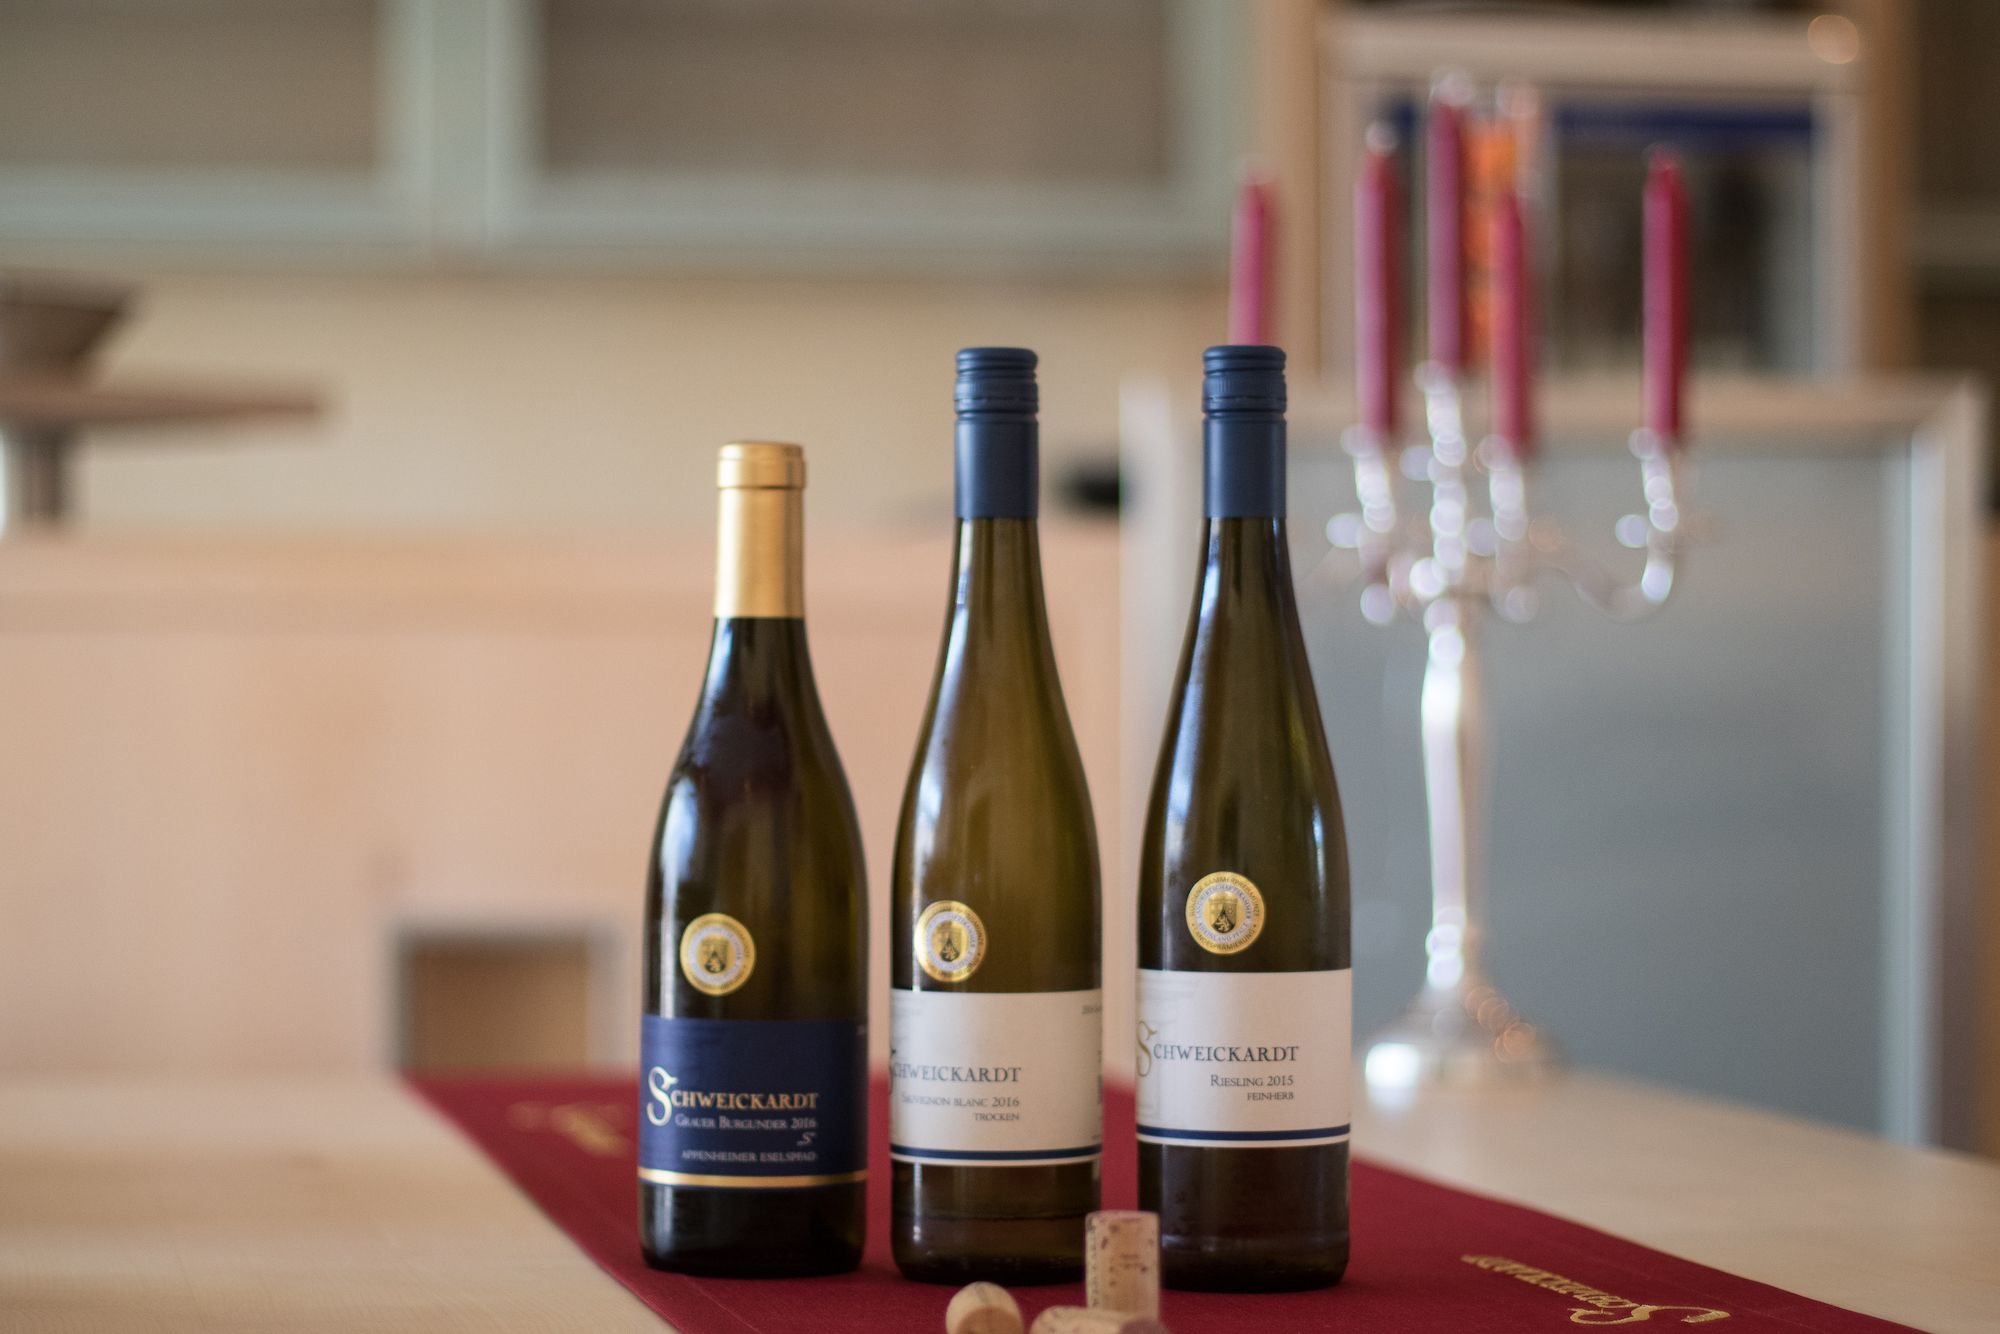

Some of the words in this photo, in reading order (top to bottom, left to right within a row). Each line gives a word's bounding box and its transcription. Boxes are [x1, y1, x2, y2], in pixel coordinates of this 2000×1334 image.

[1135, 1020, 1299, 1077] SCHWEICKARDT
[1210, 1074, 1264, 1087] RIESLING
[1267, 1075, 1294, 1087] 2015
[646, 1066, 819, 1127] SCHWEICKARDT
[954, 1097, 989, 1108] BLANC
[992, 1097, 1020, 1108] 2016
[1247, 1092, 1295, 1101] FEINHERB
[674, 1113, 716, 1129] GRAUER
[718, 1117, 788, 1130] BURGUNDER
[790, 1118, 817, 1130] 2016
[974, 1112, 1020, 1122] TROCKEN
[681, 1150, 756, 1162] APPENHEIMER
[760, 1151, 816, 1163] ESELSPFAD
